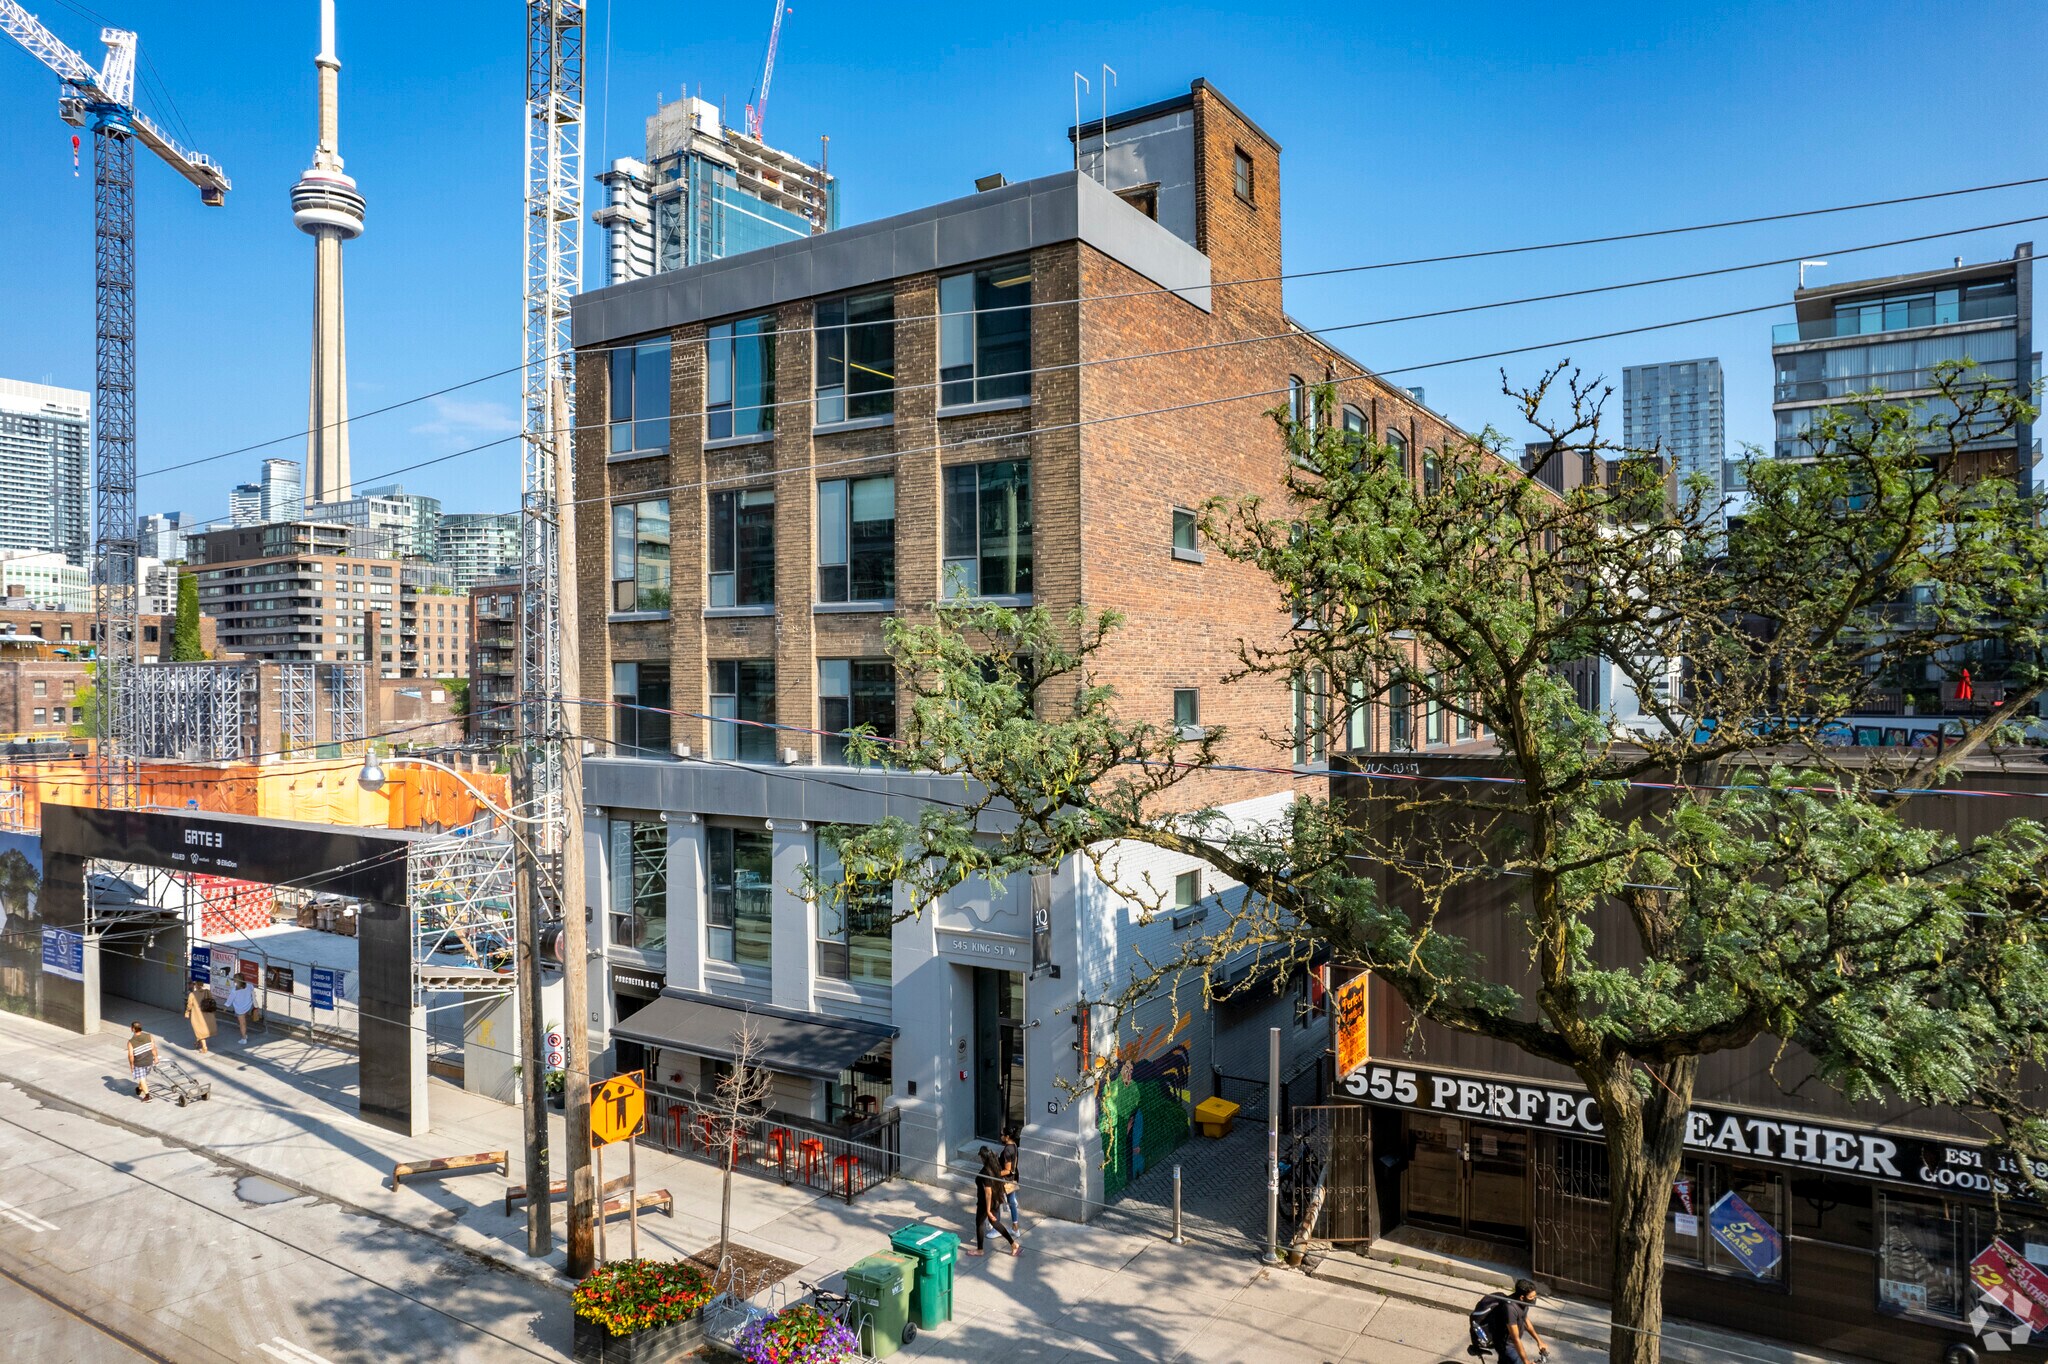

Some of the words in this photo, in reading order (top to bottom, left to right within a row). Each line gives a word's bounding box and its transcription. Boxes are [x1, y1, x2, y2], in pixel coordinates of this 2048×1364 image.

[184, 829, 213, 848] GATE
[215, 832, 222, 848] 3
[1035, 908, 1048, 926] iQ
[192, 953, 205, 962] GATE
[952, 940, 967, 951] 545
[971, 942, 991, 953] KING
[994, 945, 1004, 955] ST
[1008, 947, 1017, 957] W
[614, 974, 644, 988] PORCHETTA
[645, 980, 650, 988] &
[650, 981, 660, 990] CO.
[1345, 1066, 1418, 1104] 555
[1431, 1075, 1605, 1131] PERFEC
[1683, 1110, 1902, 1178] EATHER
[1945, 1148, 1983, 1168] EST
[1919, 1165, 2010, 1194] GOODS
[1721, 1226, 1753, 1256] YEARS
[1729, 1222, 1764, 1246] 52
[1970, 1264, 2004, 1287] 52
